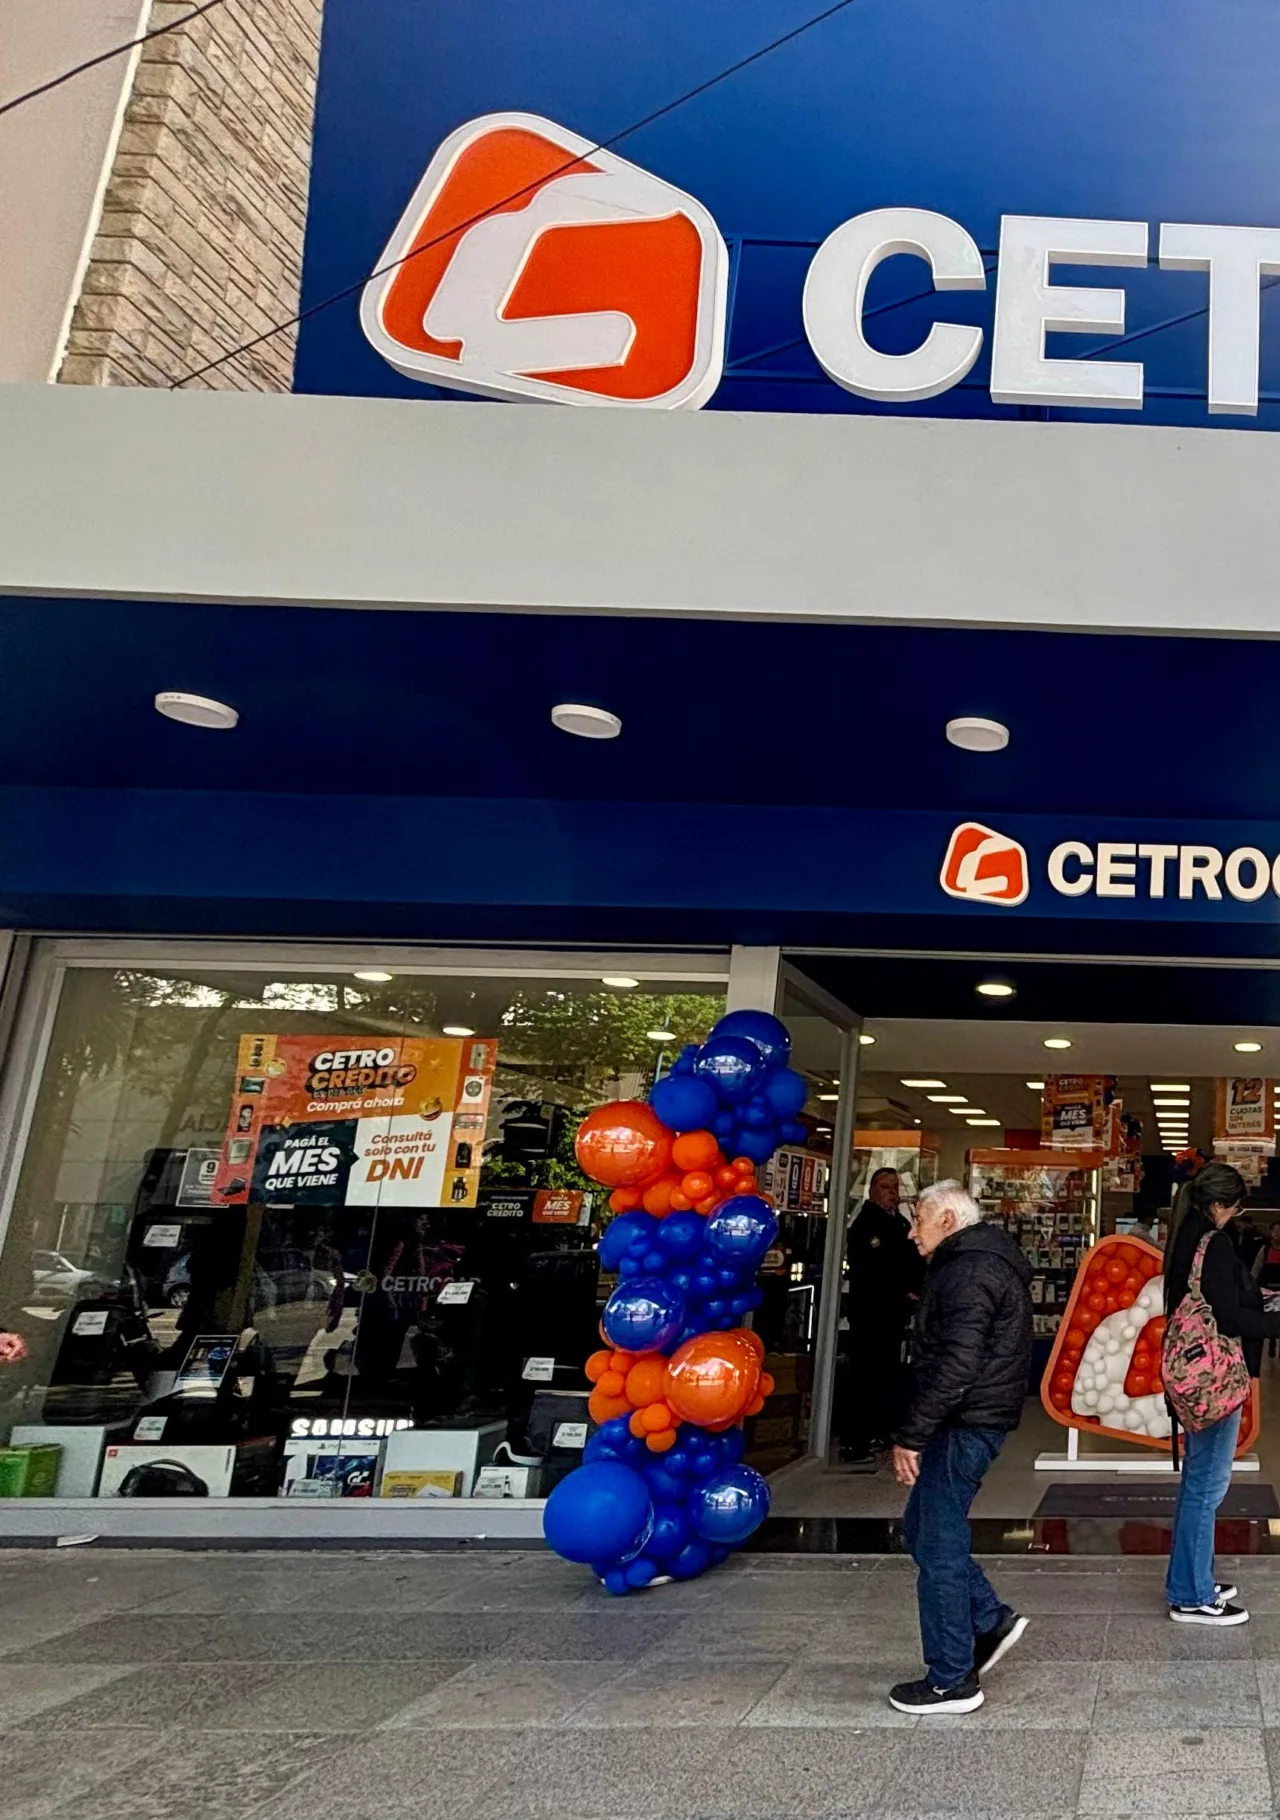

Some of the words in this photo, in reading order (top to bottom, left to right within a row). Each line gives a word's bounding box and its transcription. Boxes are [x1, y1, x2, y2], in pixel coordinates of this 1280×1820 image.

[314, 1047, 395, 1071] CETRO
[311, 1062, 416, 1090] CRÉDITO
[306, 1098, 363, 1114] Comprá
[364, 1096, 405, 1109] ahora
[1229, 1107, 1263, 1115] CUOTAS
[1060, 1109, 1087, 1120] MES
[283, 1135, 316, 1149] PAGÁ
[317, 1136, 330, 1147] EL
[371, 1130, 433, 1145] Consultá
[364, 1144, 393, 1156] solo
[394, 1146, 420, 1155] con
[421, 1143, 436, 1153] tu
[206, 1161, 217, 1175] 9
[268, 1147, 341, 1176] MES
[365, 1156, 425, 1183] DNI
[264, 1176, 297, 1191] QUE
[297, 1173, 339, 1188] VIENE
[544, 1201, 572, 1211] MES
[291, 1418, 415, 1437] SAMSU
